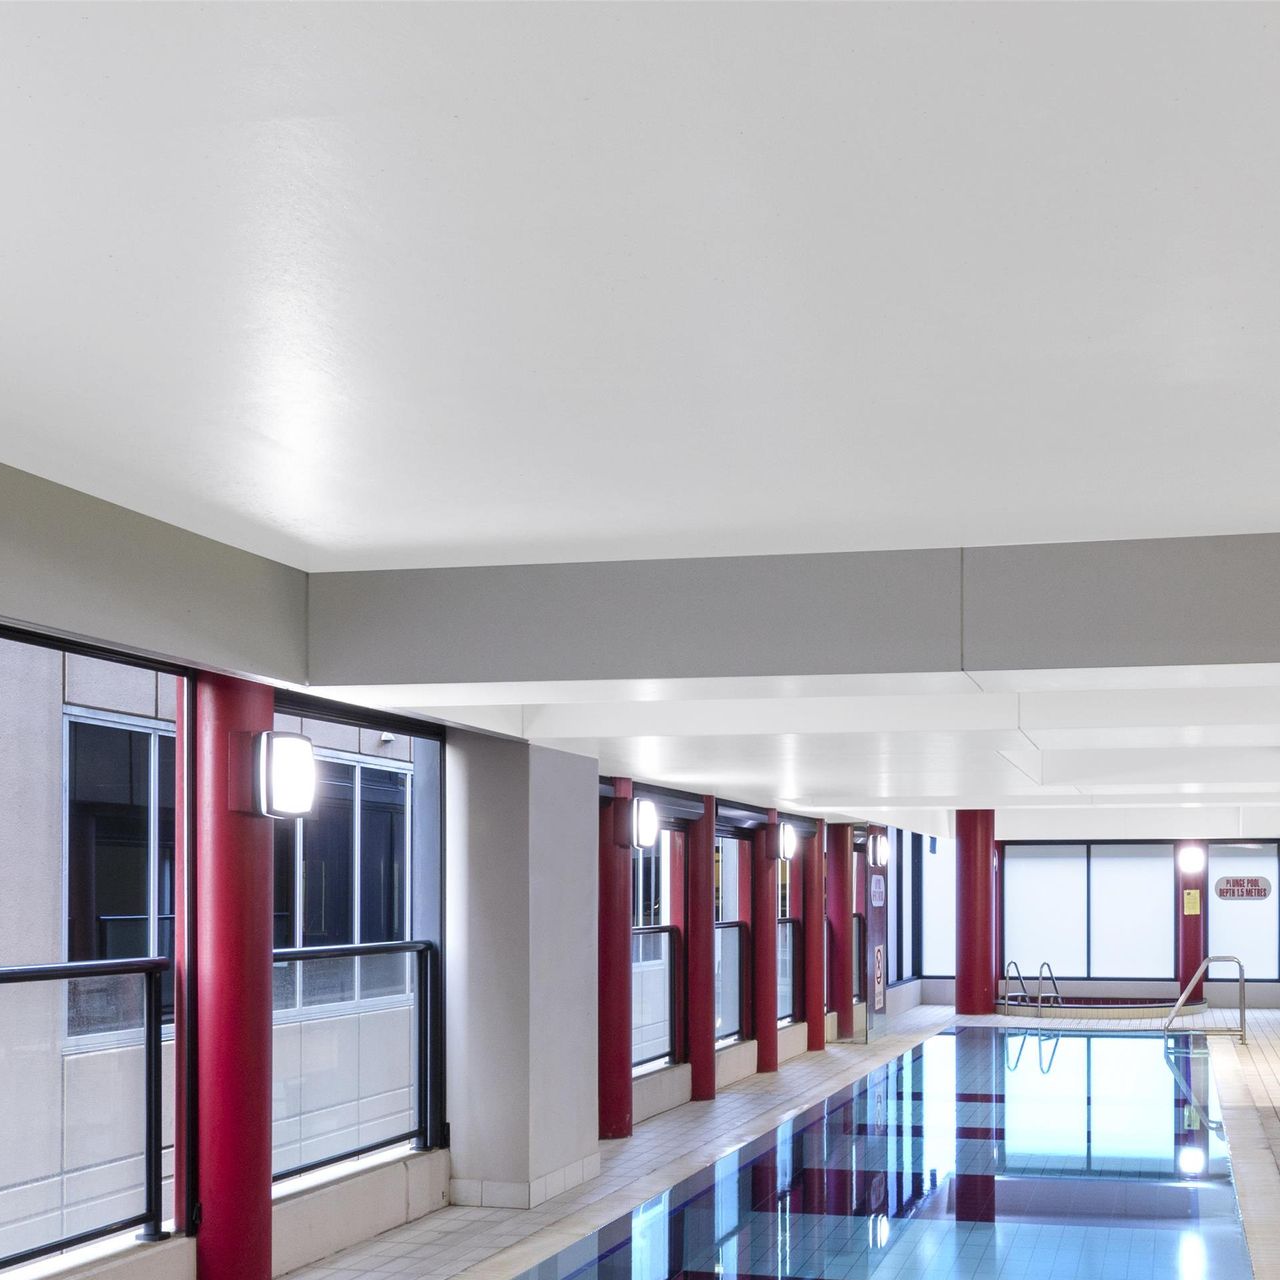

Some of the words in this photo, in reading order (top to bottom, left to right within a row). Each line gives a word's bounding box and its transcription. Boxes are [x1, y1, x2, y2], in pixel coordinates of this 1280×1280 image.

[1226, 879, 1245, 887] PLUNGE
[1247, 879, 1259, 887] POOL
[1219, 888, 1235, 897] DEPTH
[1246, 888, 1267, 897] METRES
